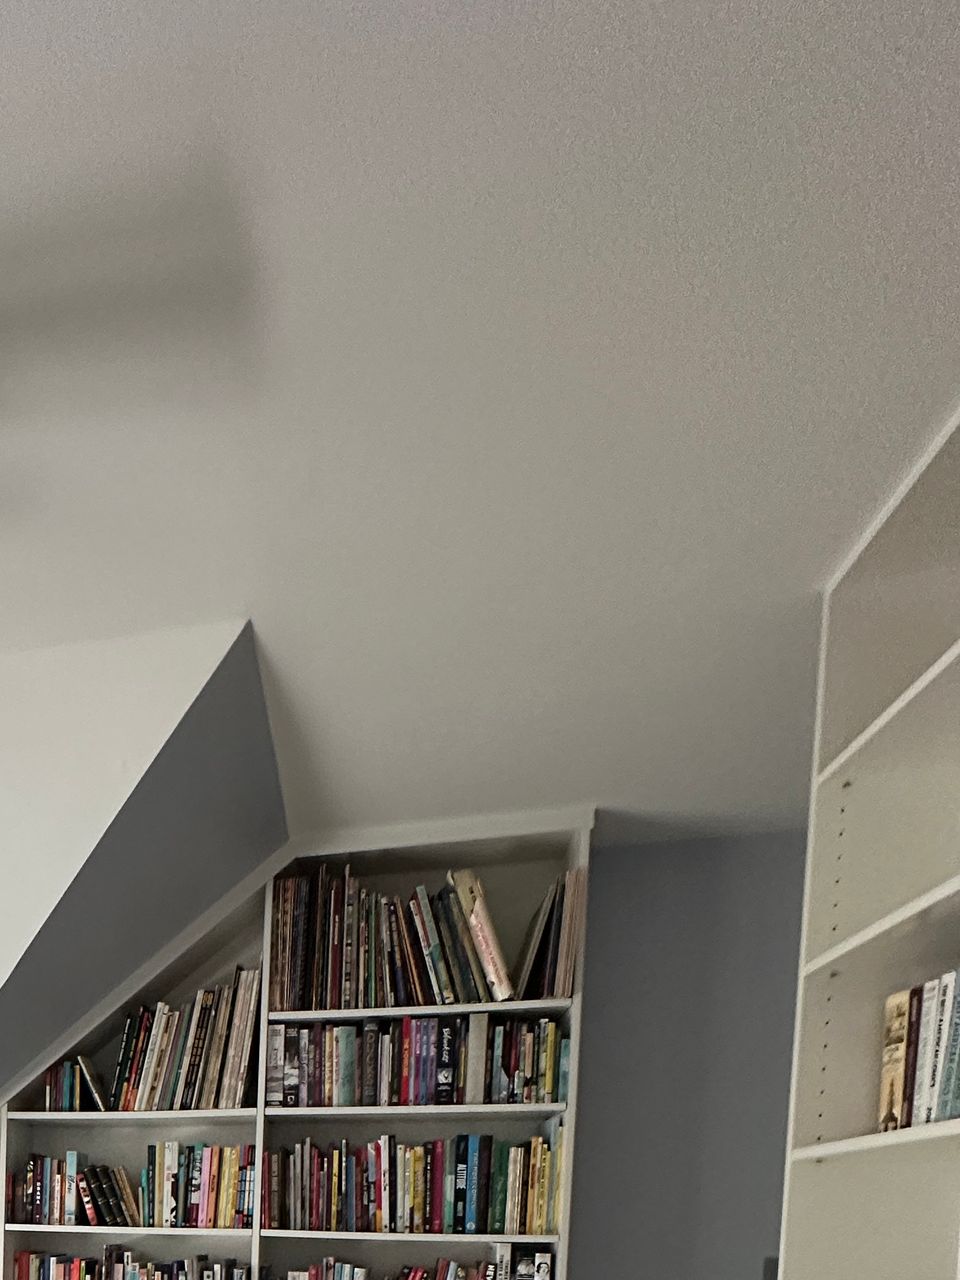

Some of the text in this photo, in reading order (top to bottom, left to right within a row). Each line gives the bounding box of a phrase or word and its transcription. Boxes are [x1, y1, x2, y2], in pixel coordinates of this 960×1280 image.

[934, 1018, 944, 1058] AMERICAN
[929, 1059, 938, 1088] COMICS
[456, 1163, 467, 1190] ALTITUDE
